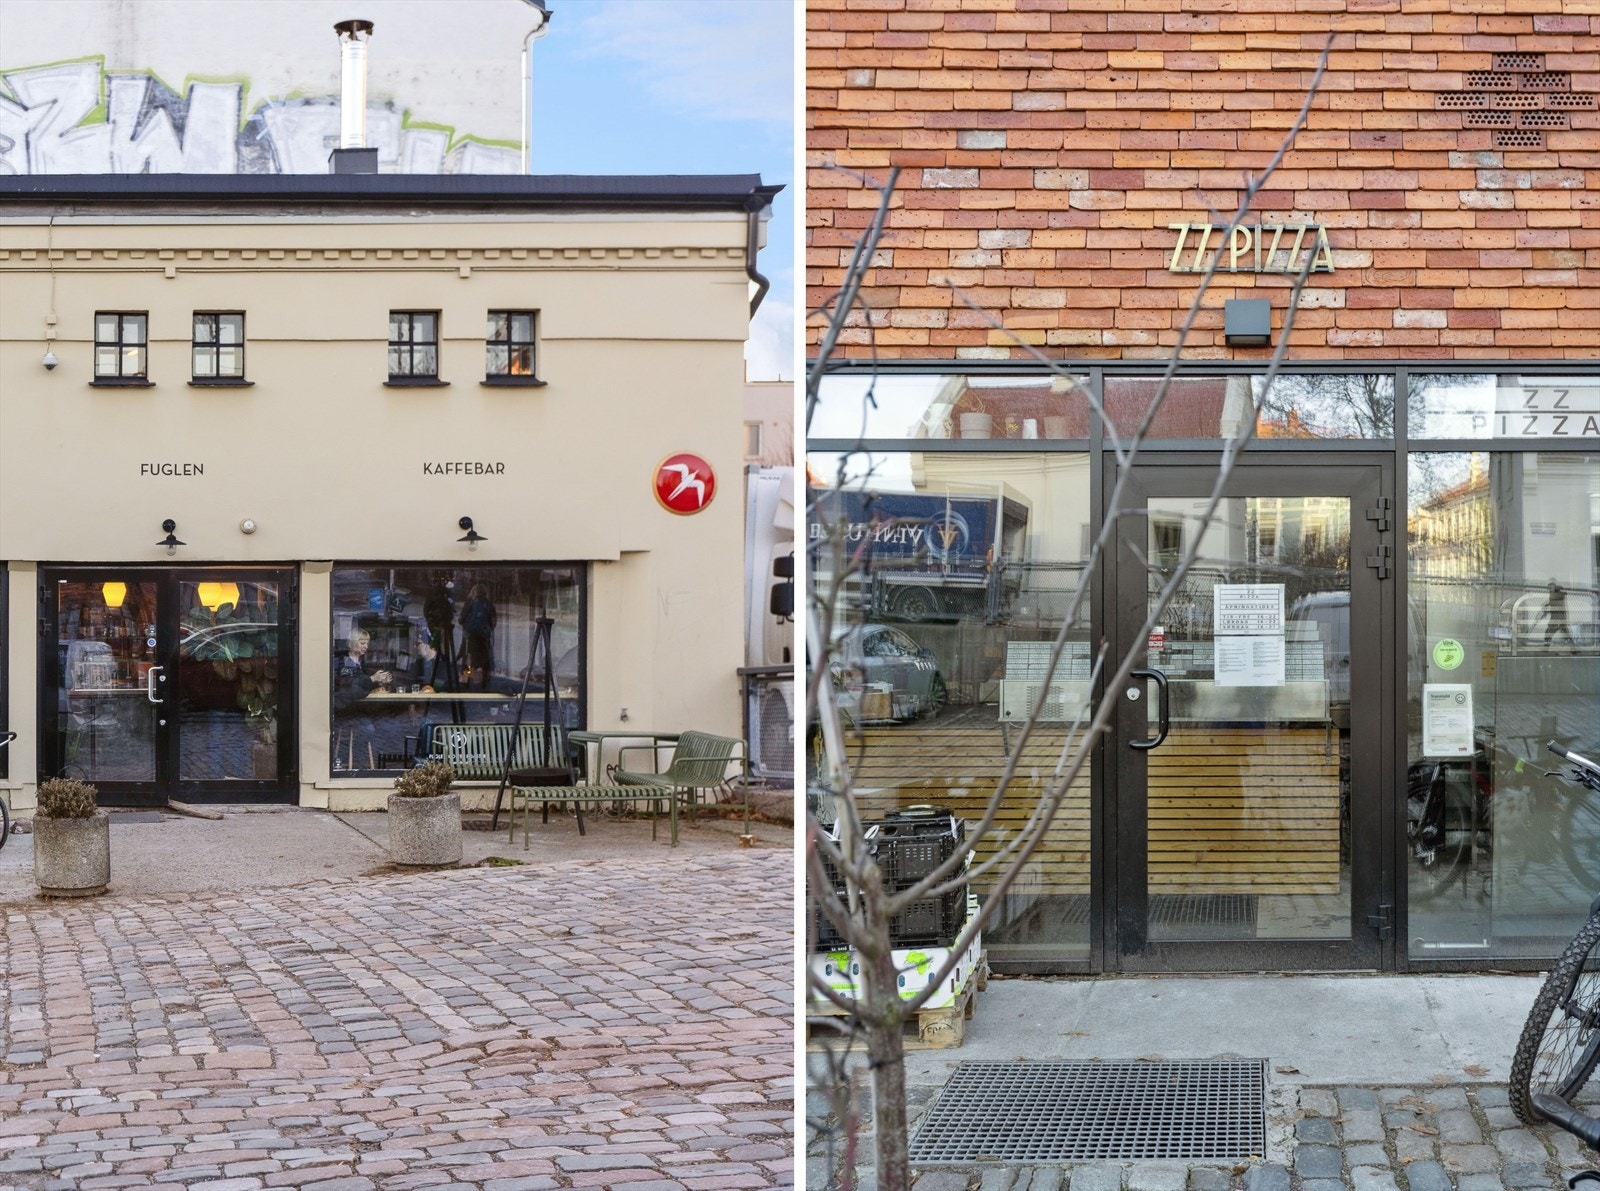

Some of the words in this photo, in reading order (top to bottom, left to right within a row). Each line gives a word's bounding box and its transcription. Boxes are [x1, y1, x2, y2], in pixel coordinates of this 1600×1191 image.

[1168, 223, 1212, 272] ZZ
[1230, 223, 1335, 272] PIZZA
[1472, 415, 1600, 435] PIZZA
[140, 463, 204, 476] FUGLEN
[423, 462, 505, 475] KAFFEBAR
